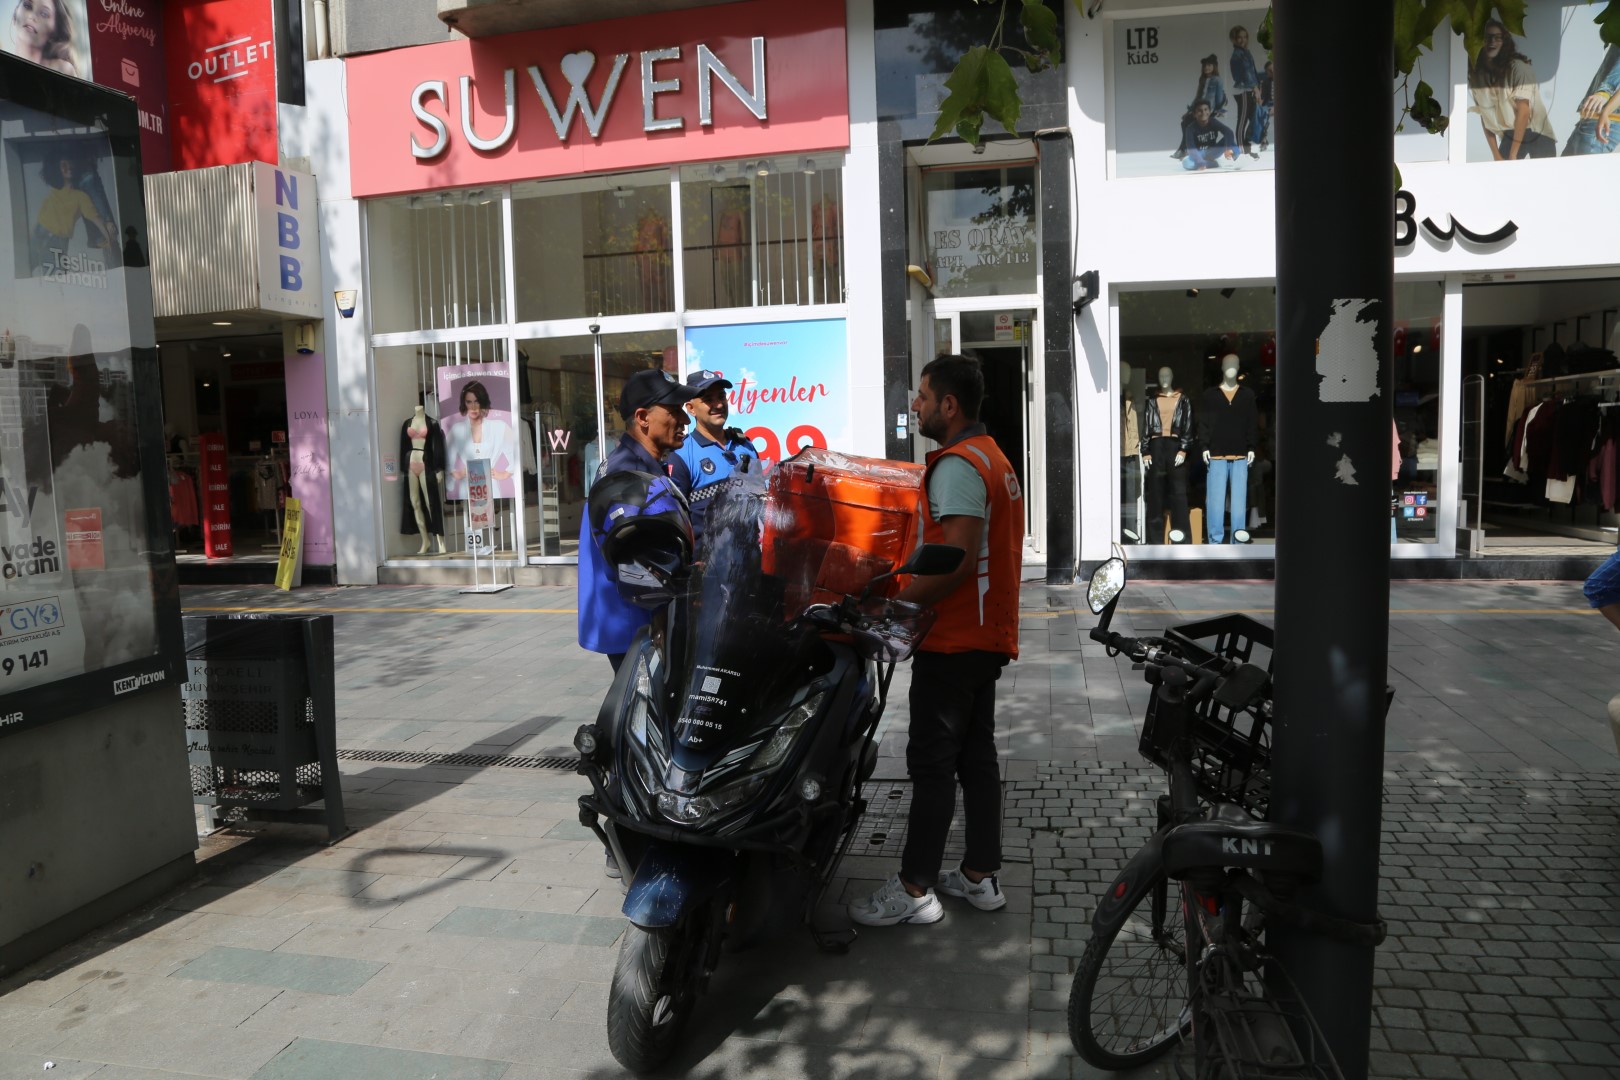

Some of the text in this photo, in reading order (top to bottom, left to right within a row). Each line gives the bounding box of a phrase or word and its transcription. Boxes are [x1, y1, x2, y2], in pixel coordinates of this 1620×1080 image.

[1126, 26, 1159, 50] LTB
[188, 41, 271, 80] OUTLET
[1127, 51, 1159, 65] Kids
[410, 36, 767, 159] SUWEN
[274, 169, 303, 292] NBB
[934, 226, 1027, 249] ES ORAY
[49, 247, 105, 275] Teslim
[1006, 252, 1029, 264] 113
[294, 411, 319, 420] LOYA
[2, 536, 55, 561] vade
[3, 557, 60, 579] oranı
[18, 649, 48, 672] 141
[1222, 837, 1275, 856] KNT
